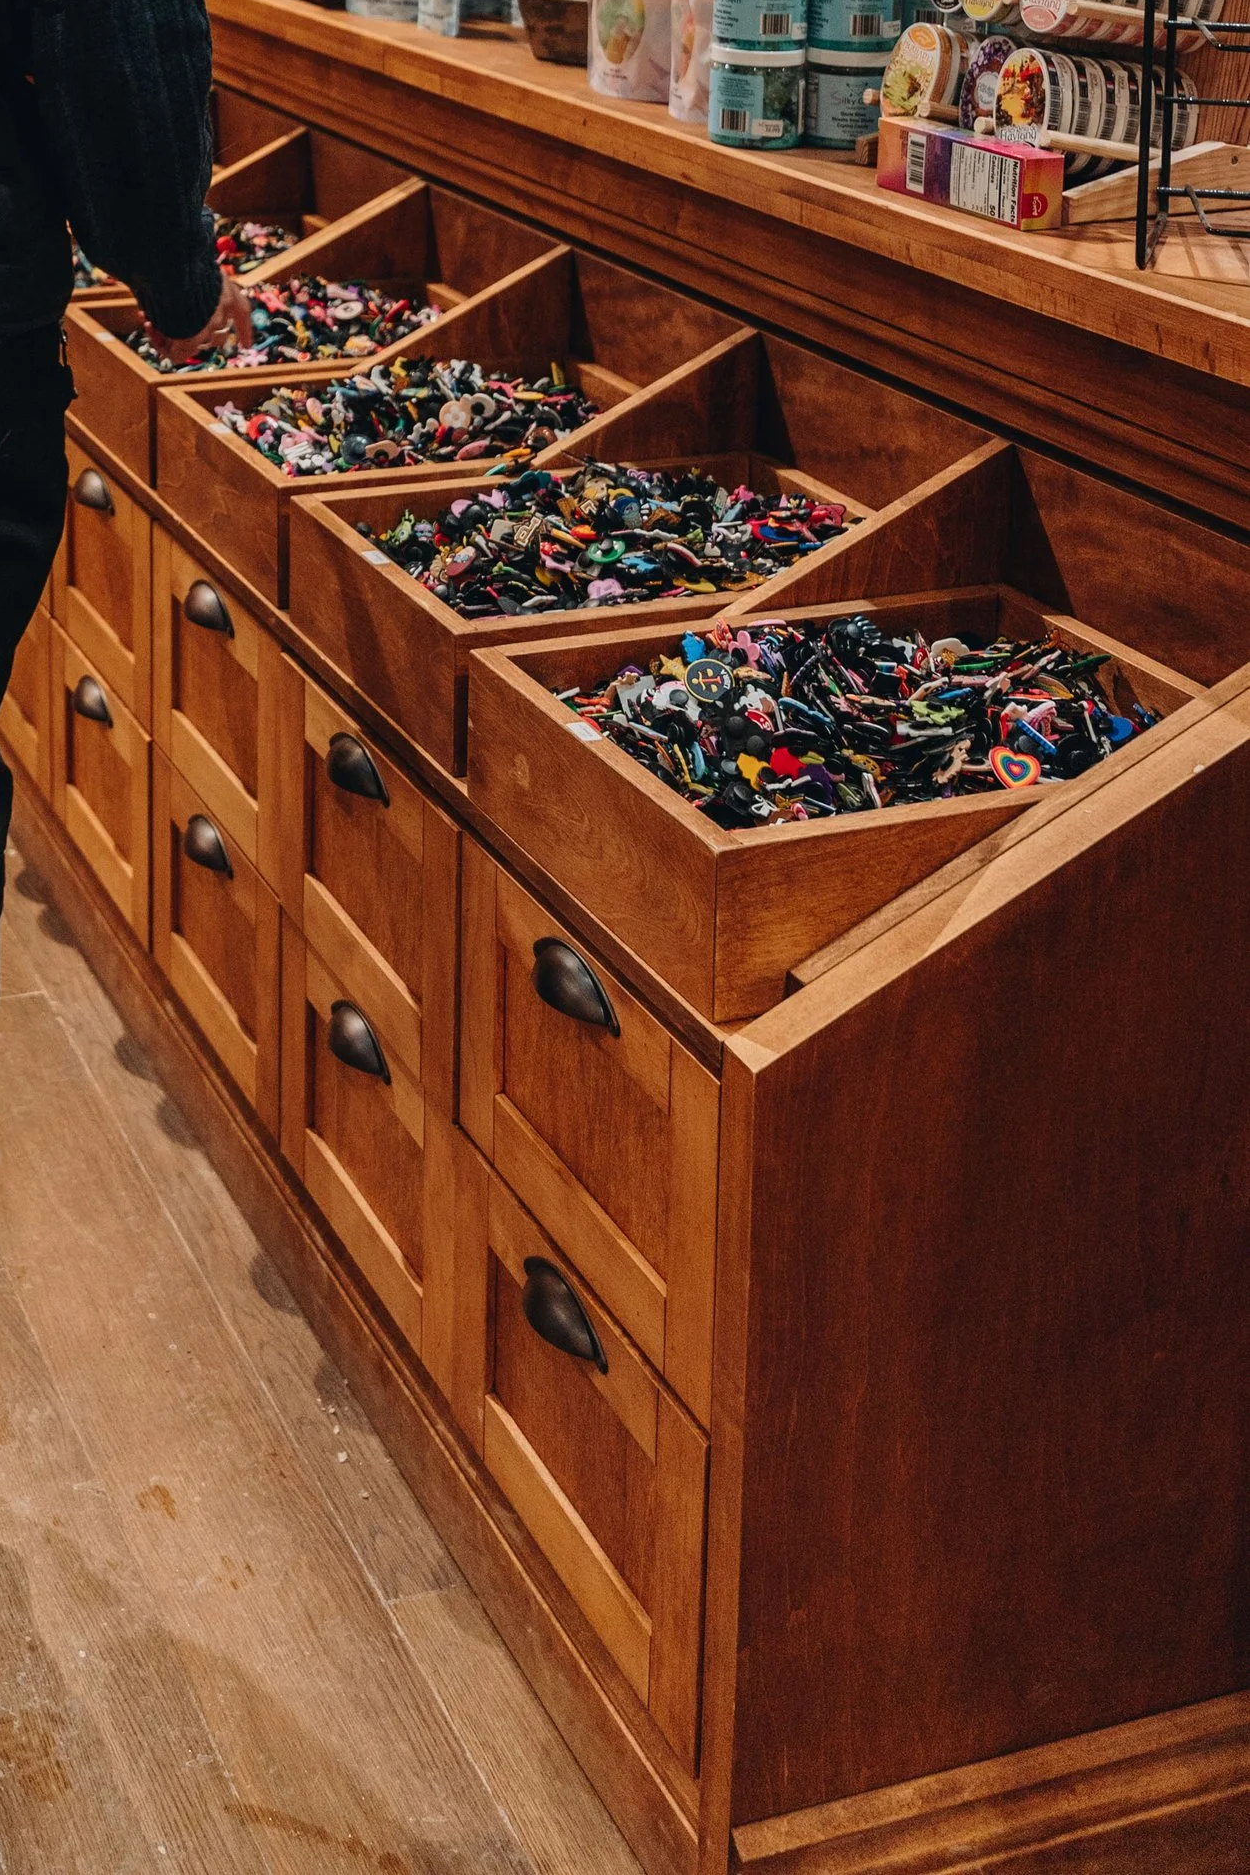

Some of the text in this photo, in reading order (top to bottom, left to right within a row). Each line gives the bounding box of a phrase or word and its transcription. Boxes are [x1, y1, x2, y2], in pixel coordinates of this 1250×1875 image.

[1009, 160, 1020, 223] Nutrition Facts
[989, 205, 996, 217] 50
